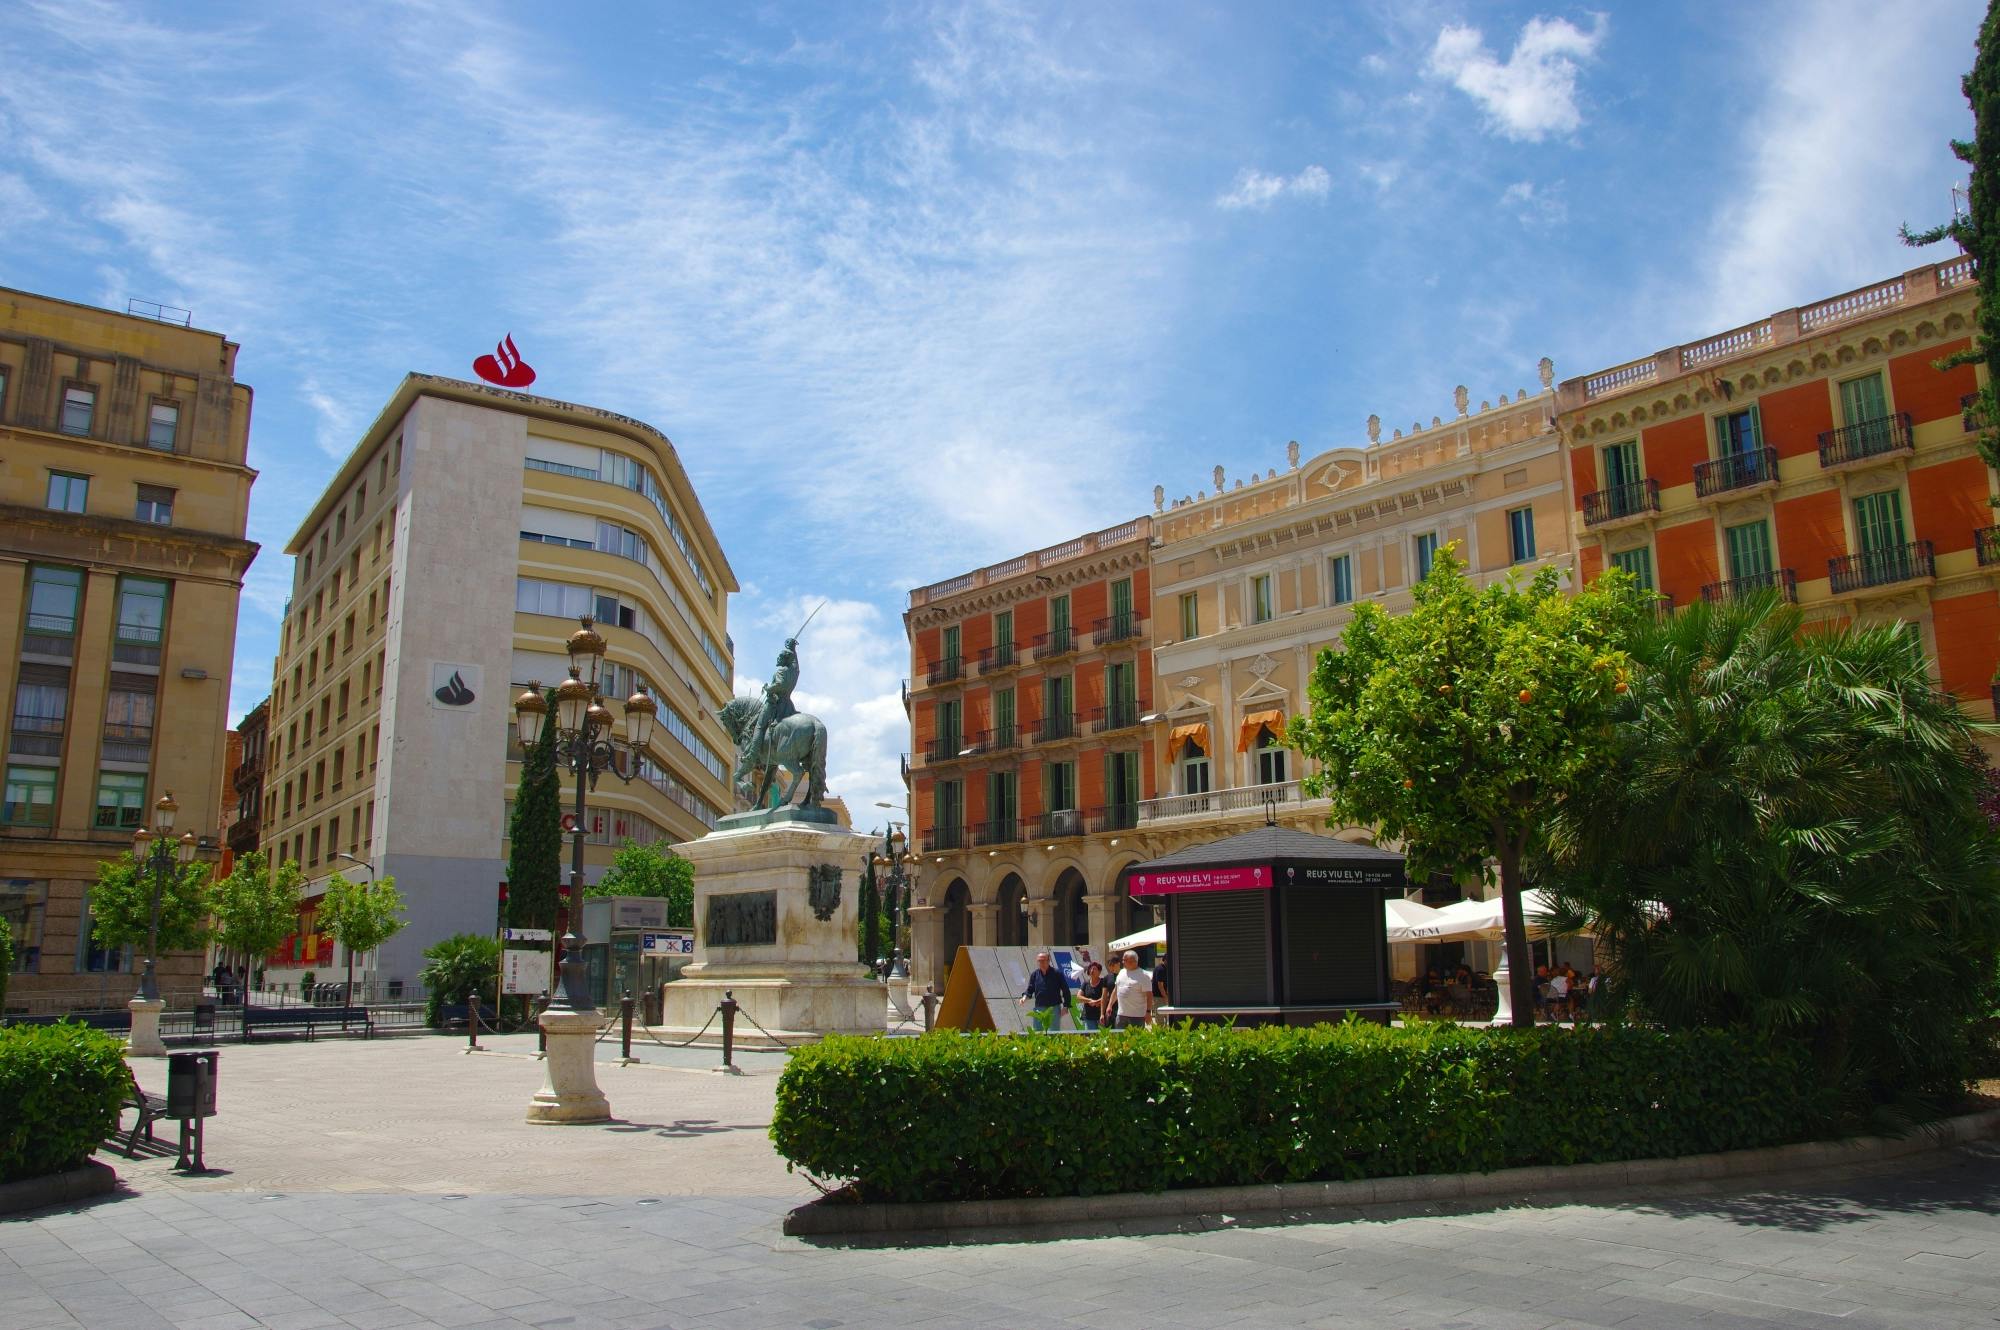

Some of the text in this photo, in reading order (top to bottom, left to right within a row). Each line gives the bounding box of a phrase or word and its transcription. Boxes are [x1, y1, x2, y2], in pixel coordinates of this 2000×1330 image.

[1192, 875, 1202, 883] EL
[1203, 874, 1211, 882] VI
[1306, 870, 1363, 878] REUS VIU EL VI
[685, 941, 692, 953] 3
